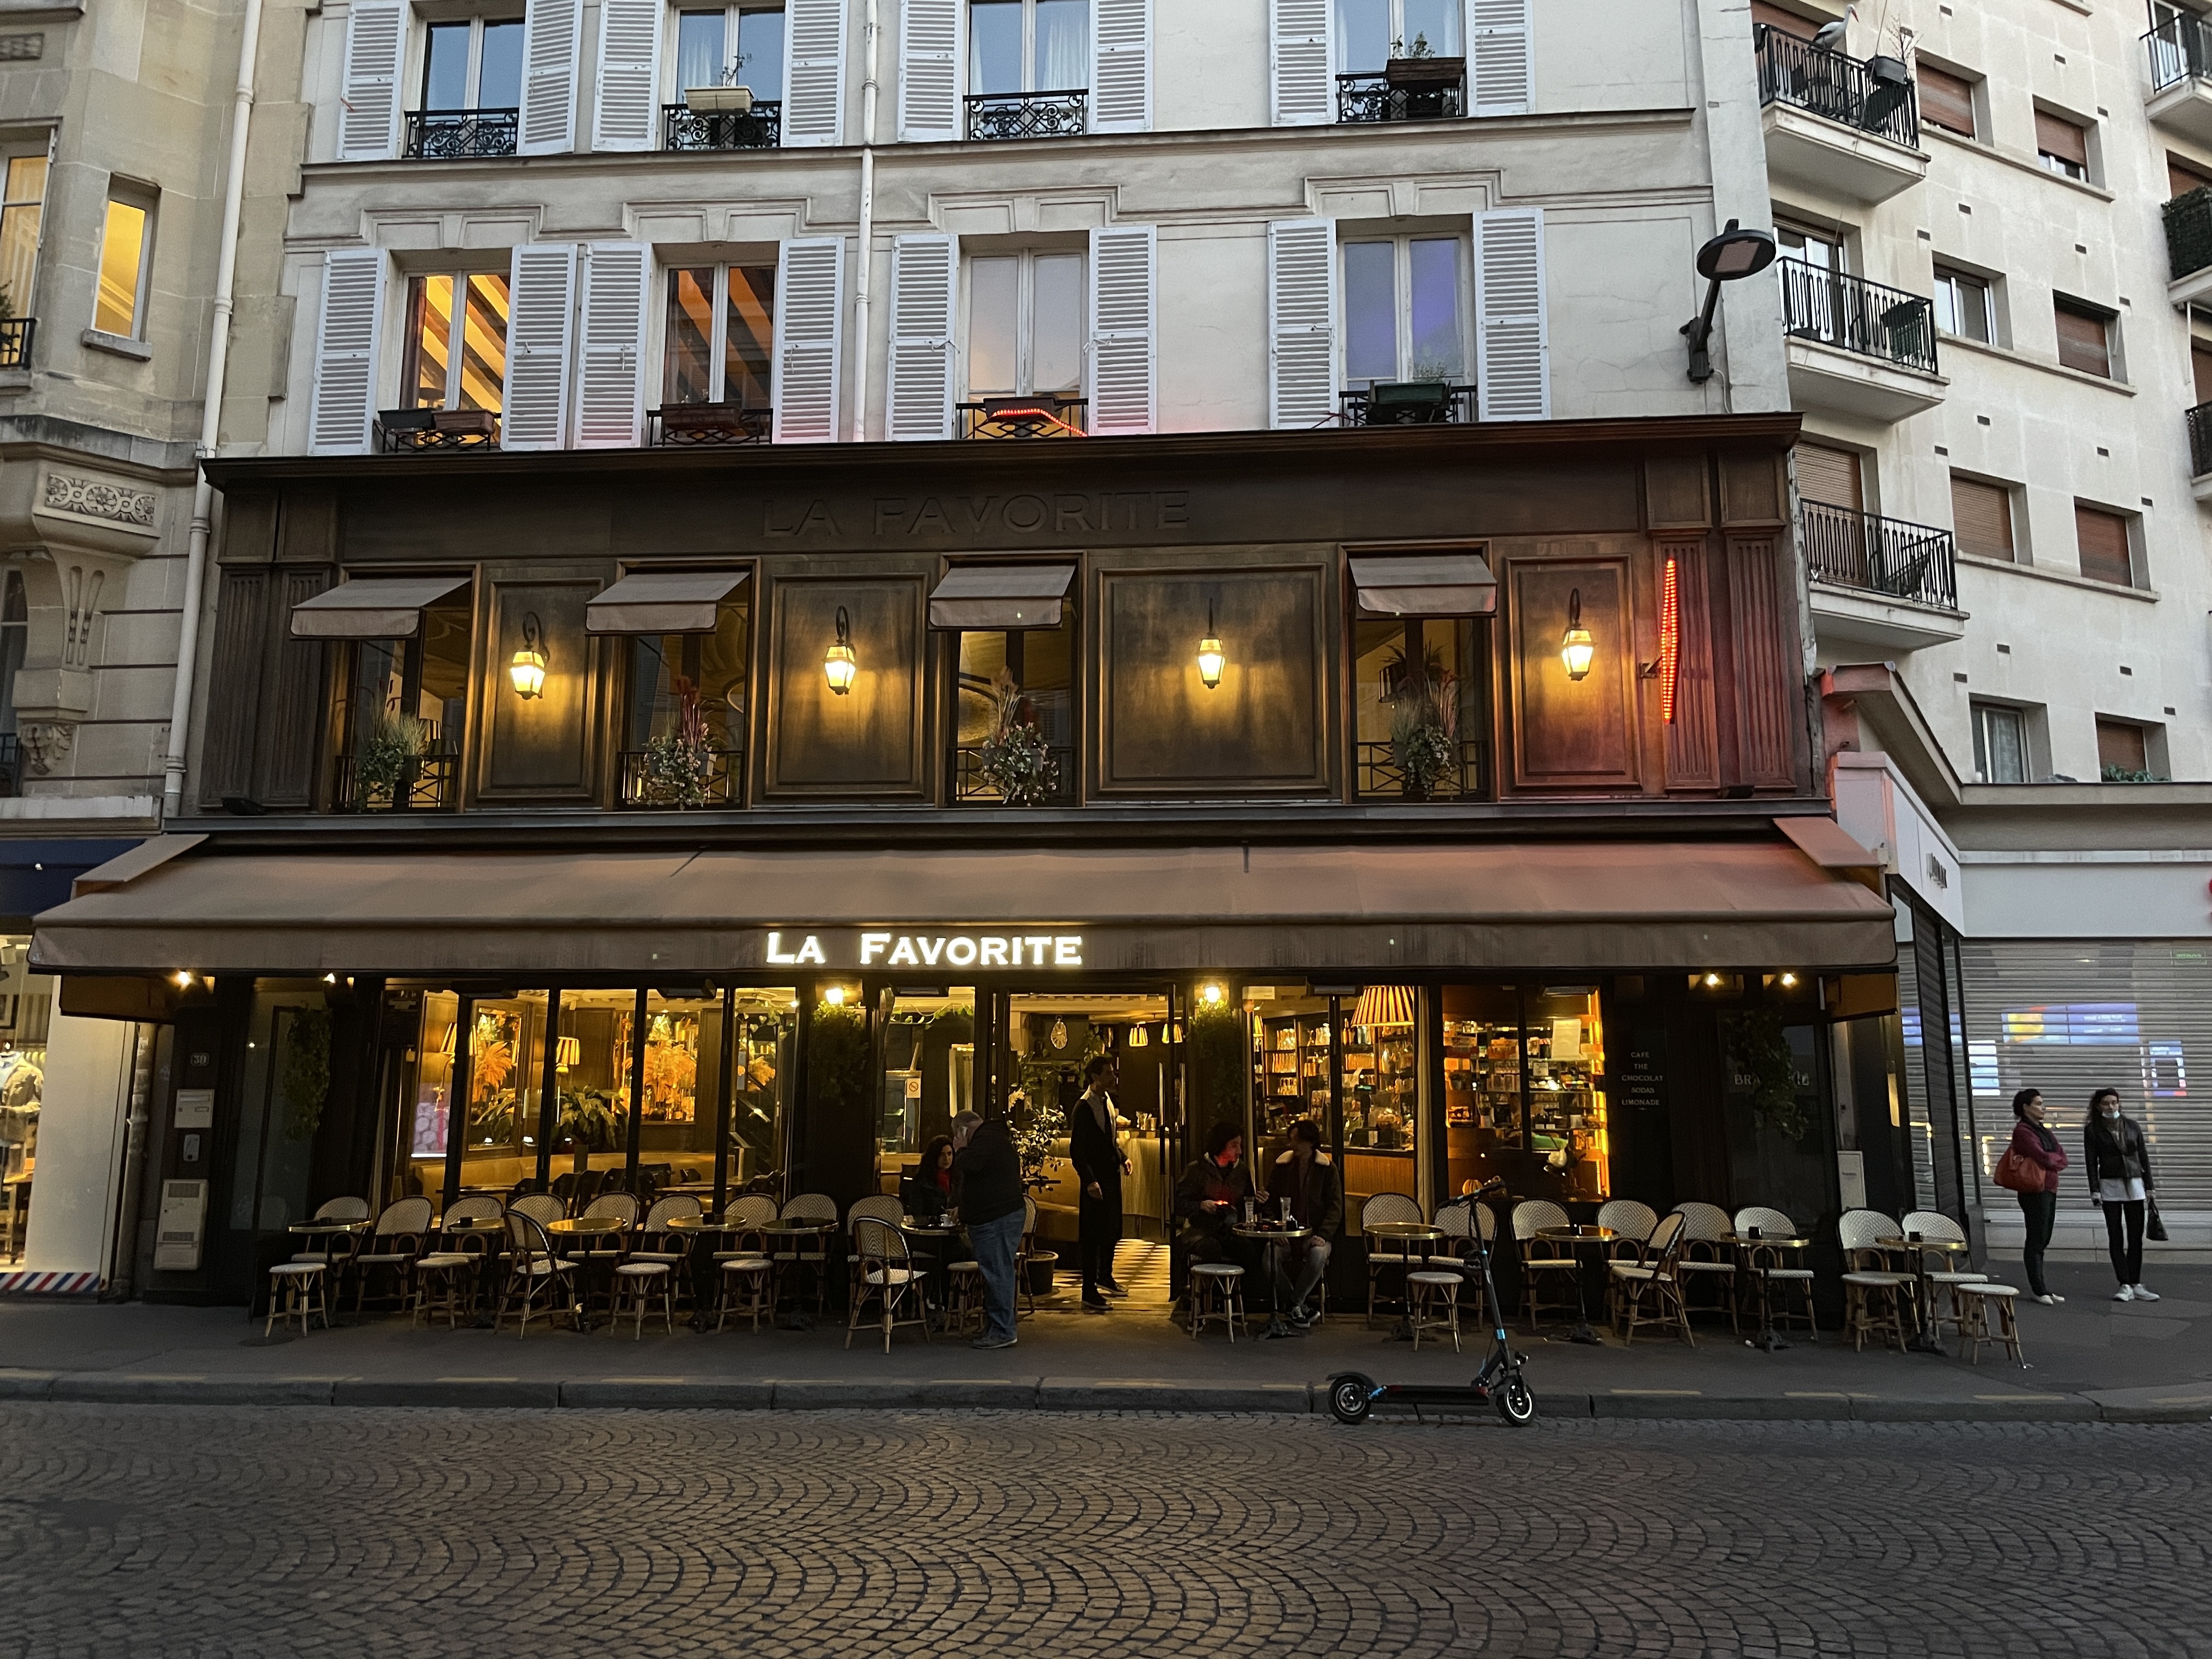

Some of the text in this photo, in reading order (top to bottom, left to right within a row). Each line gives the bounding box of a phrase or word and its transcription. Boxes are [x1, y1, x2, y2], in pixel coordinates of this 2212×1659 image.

[761, 490, 1190, 537] LA FAVORITE
[766, 932, 1082, 966] LA FAVORITE
[193, 1054, 207, 1064] 30
